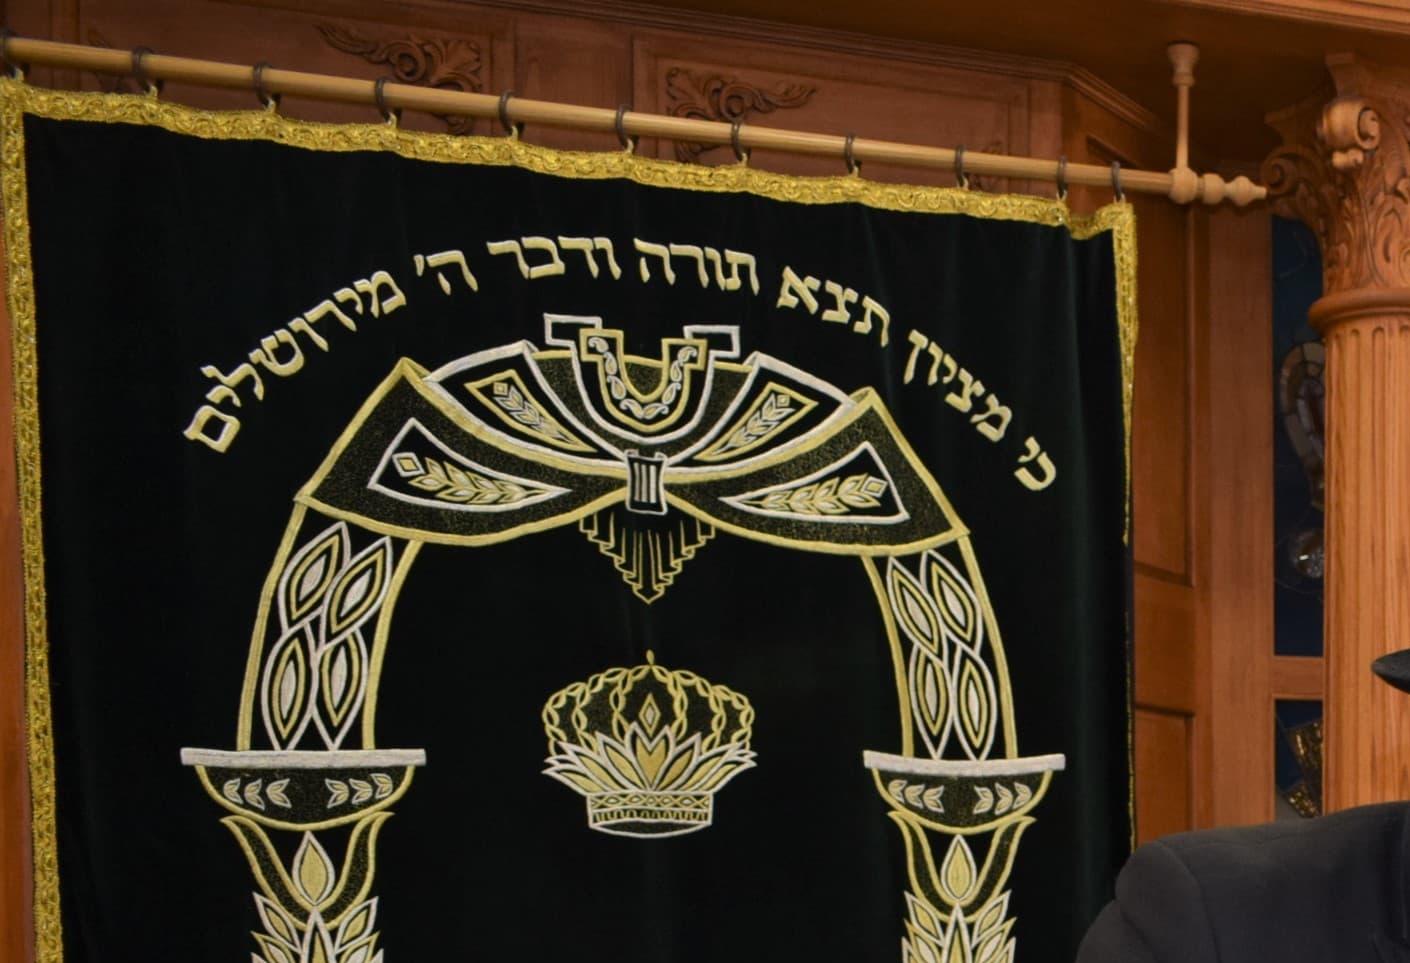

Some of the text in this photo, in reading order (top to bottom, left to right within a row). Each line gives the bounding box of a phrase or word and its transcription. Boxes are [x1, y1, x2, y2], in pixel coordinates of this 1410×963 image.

[486, 235, 622, 281] ודבר
[633, 237, 760, 296] תורה
[776, 265, 891, 348] תצא
[183, 270, 407, 454] מירושלים
[903, 329, 1013, 443] מציון
[1014, 436, 1057, 491] כי
